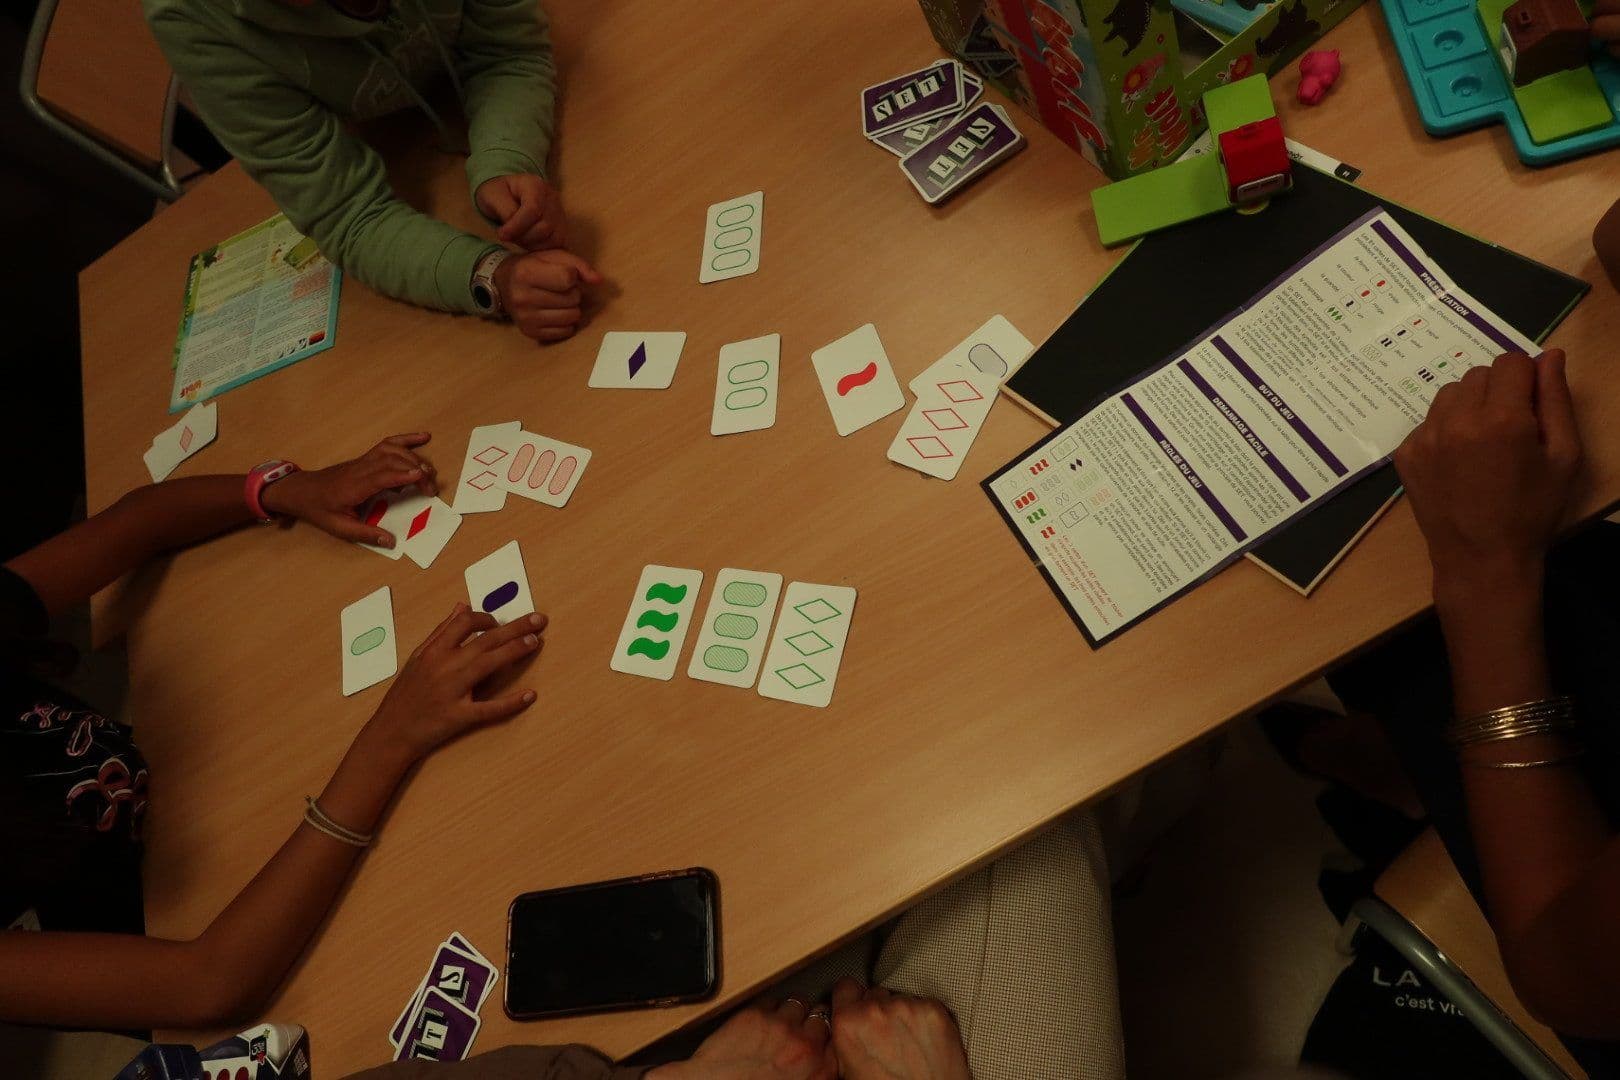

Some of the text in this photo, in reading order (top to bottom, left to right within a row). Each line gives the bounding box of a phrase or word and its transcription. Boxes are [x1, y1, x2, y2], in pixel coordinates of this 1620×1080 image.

[873, 76, 939, 121] SET
[1257, 383, 1295, 420] BUT DU JEU
[1178, 462, 1192, 475] DU
[1186, 473, 1202, 489] JEU
[1394, 993, 1436, 1012] c'est
